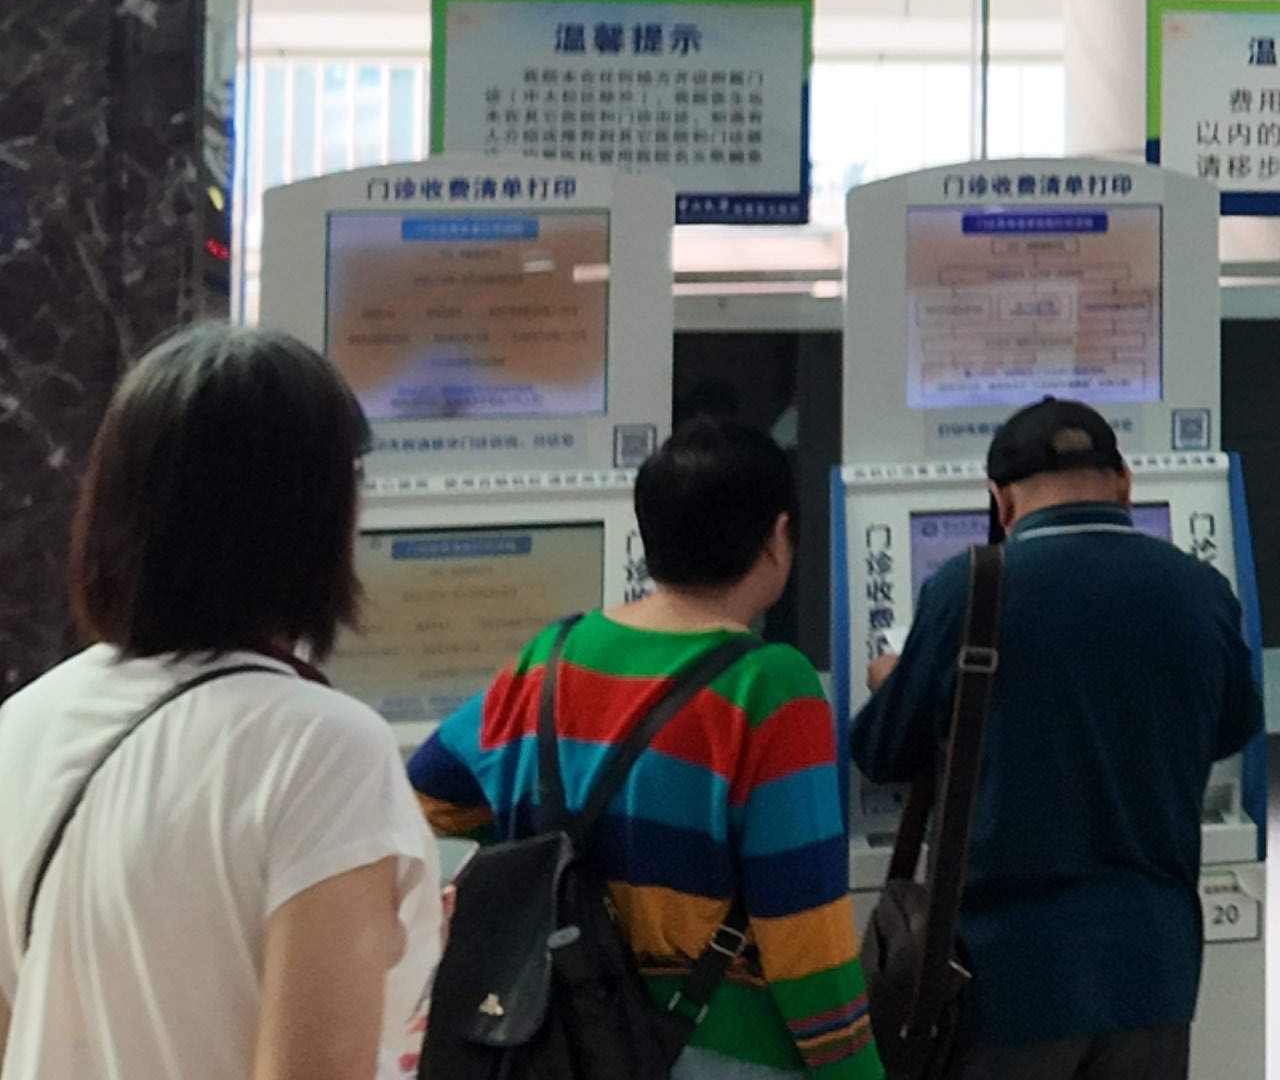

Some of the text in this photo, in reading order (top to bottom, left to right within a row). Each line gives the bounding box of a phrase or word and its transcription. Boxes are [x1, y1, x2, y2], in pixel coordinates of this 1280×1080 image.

[555, 22, 701, 56] 温馨提示
[367, 176, 577, 200] 门诊收费清单打印
[943, 174, 1132, 197] 门诊收费清单打印
[1213, 903, 1240, 926] 20
